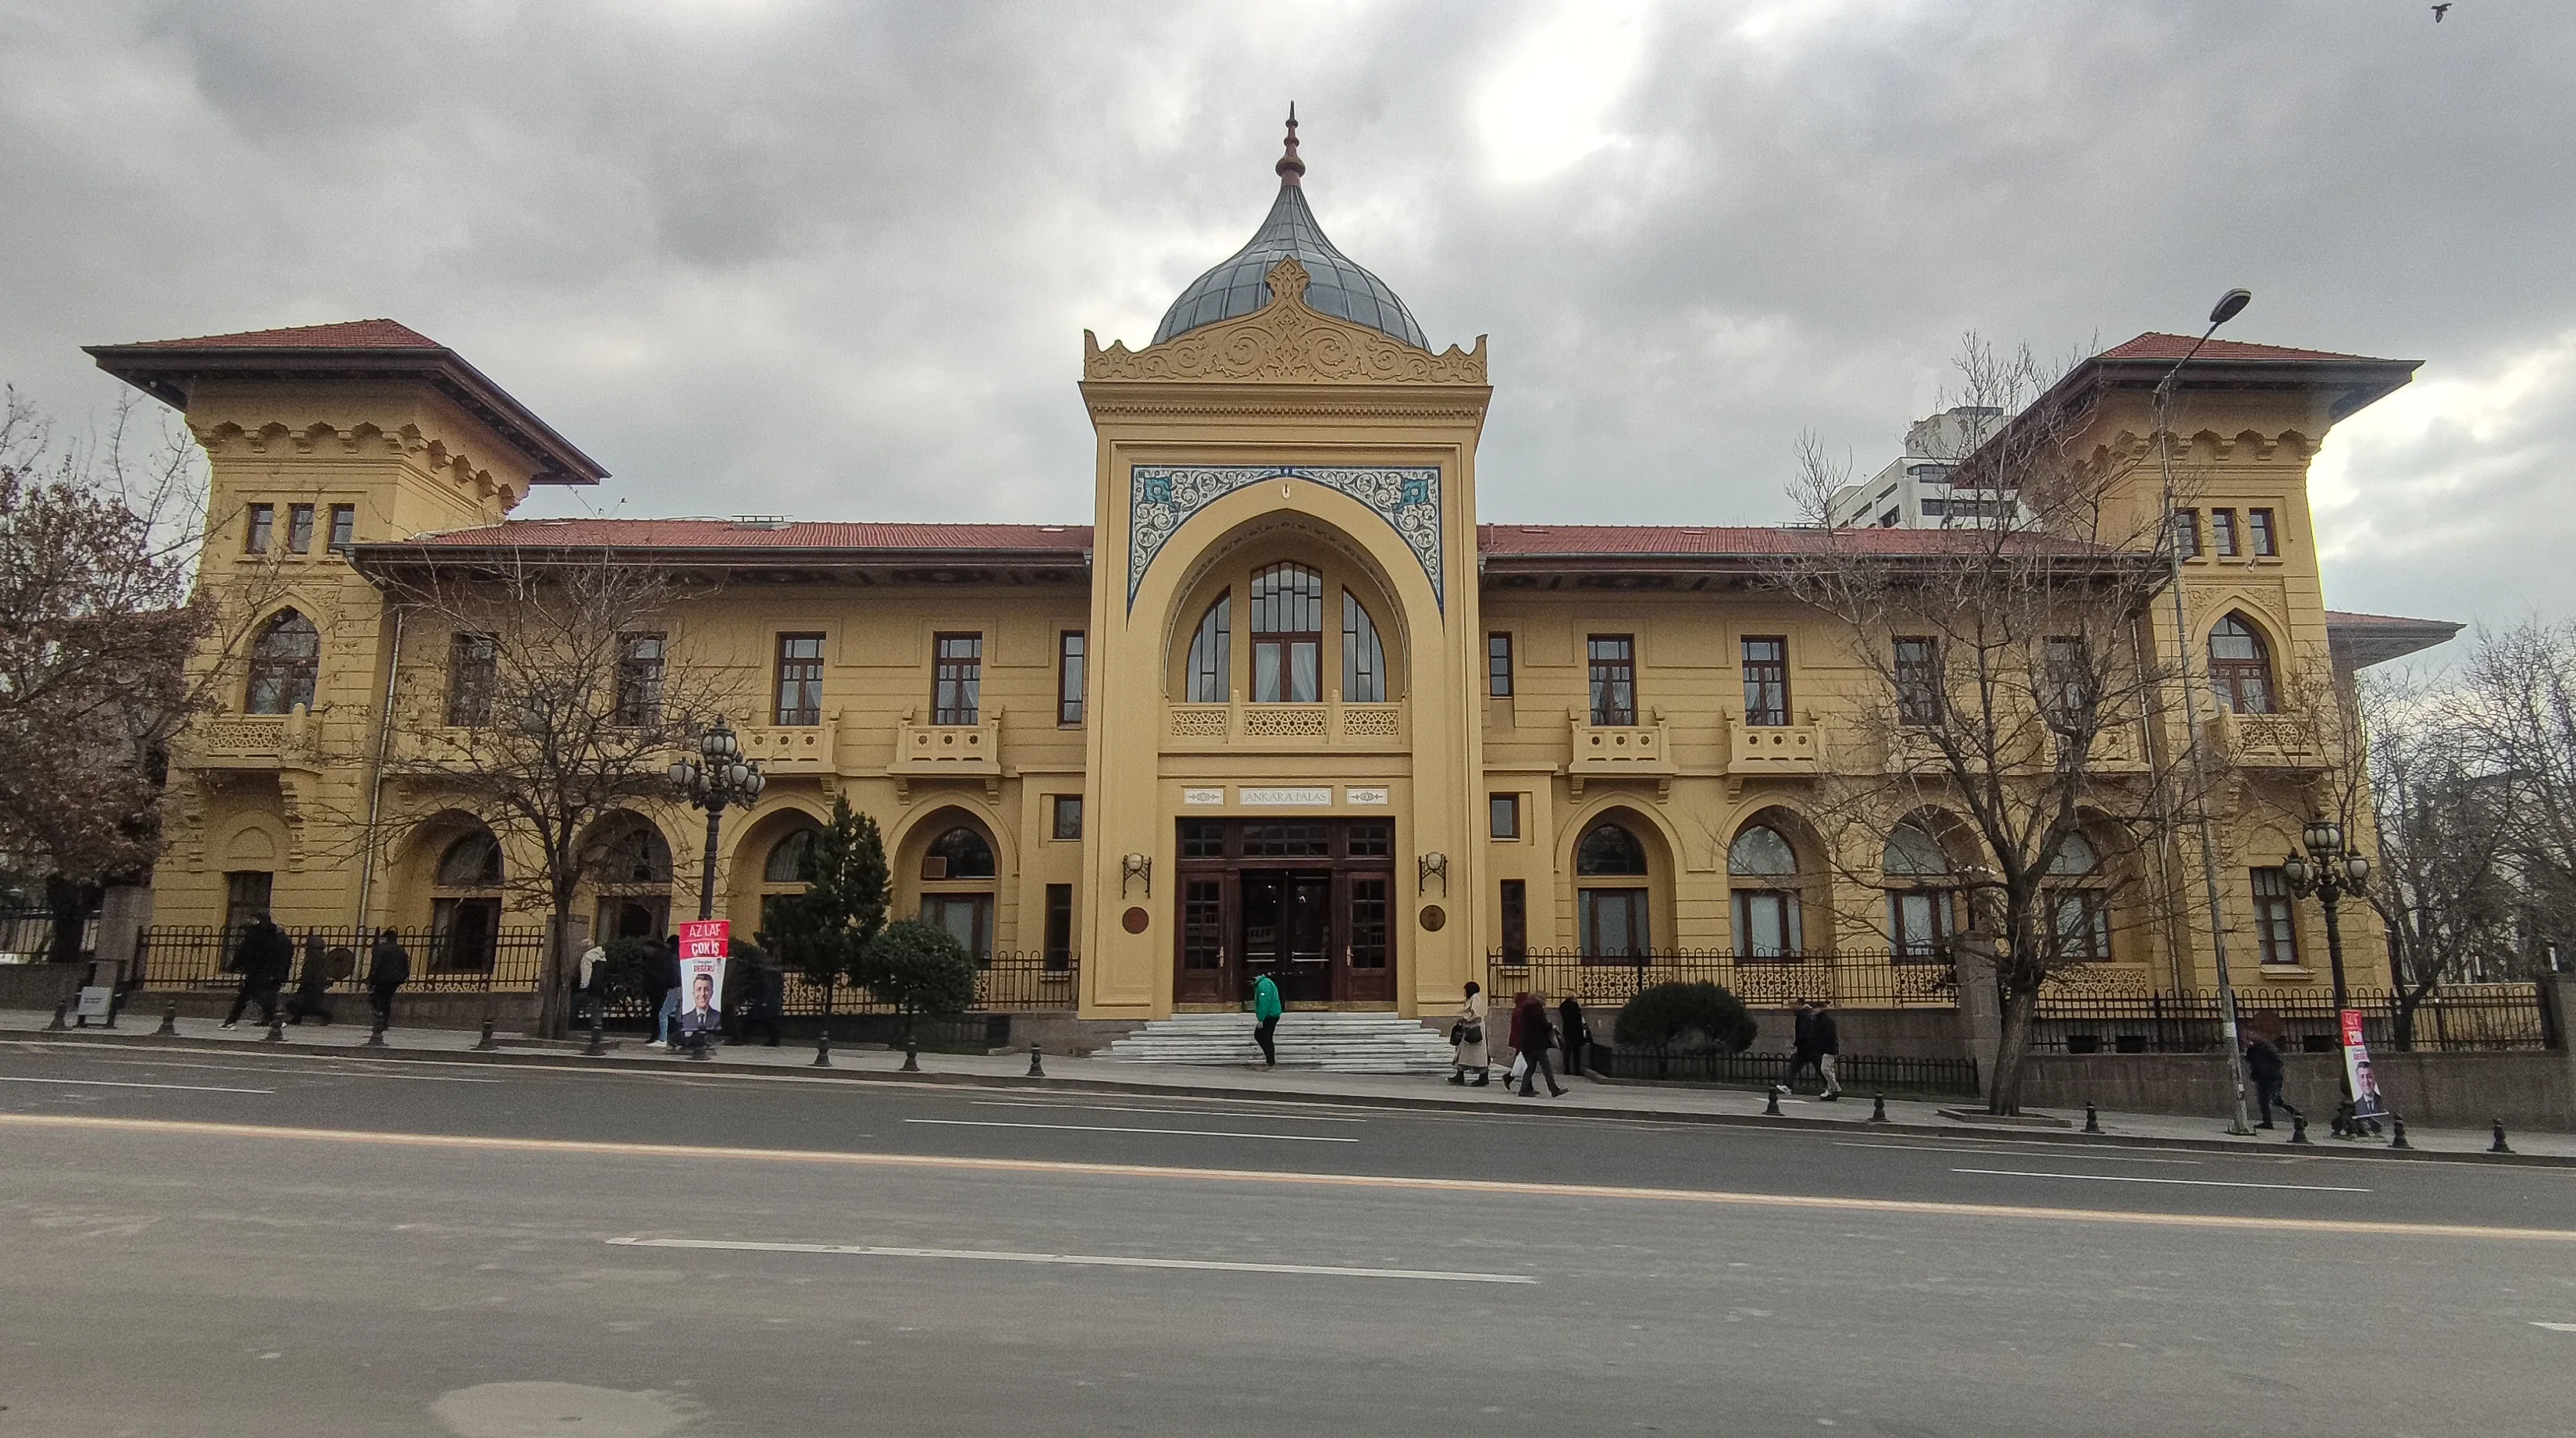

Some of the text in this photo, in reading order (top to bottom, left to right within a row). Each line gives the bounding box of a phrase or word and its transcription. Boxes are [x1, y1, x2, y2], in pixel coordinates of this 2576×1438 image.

[1245, 792, 1327, 802] ANKARA PALAS
[689, 923, 721, 937] AZ LAF
[691, 940, 720, 957] ÇOK İŞ
